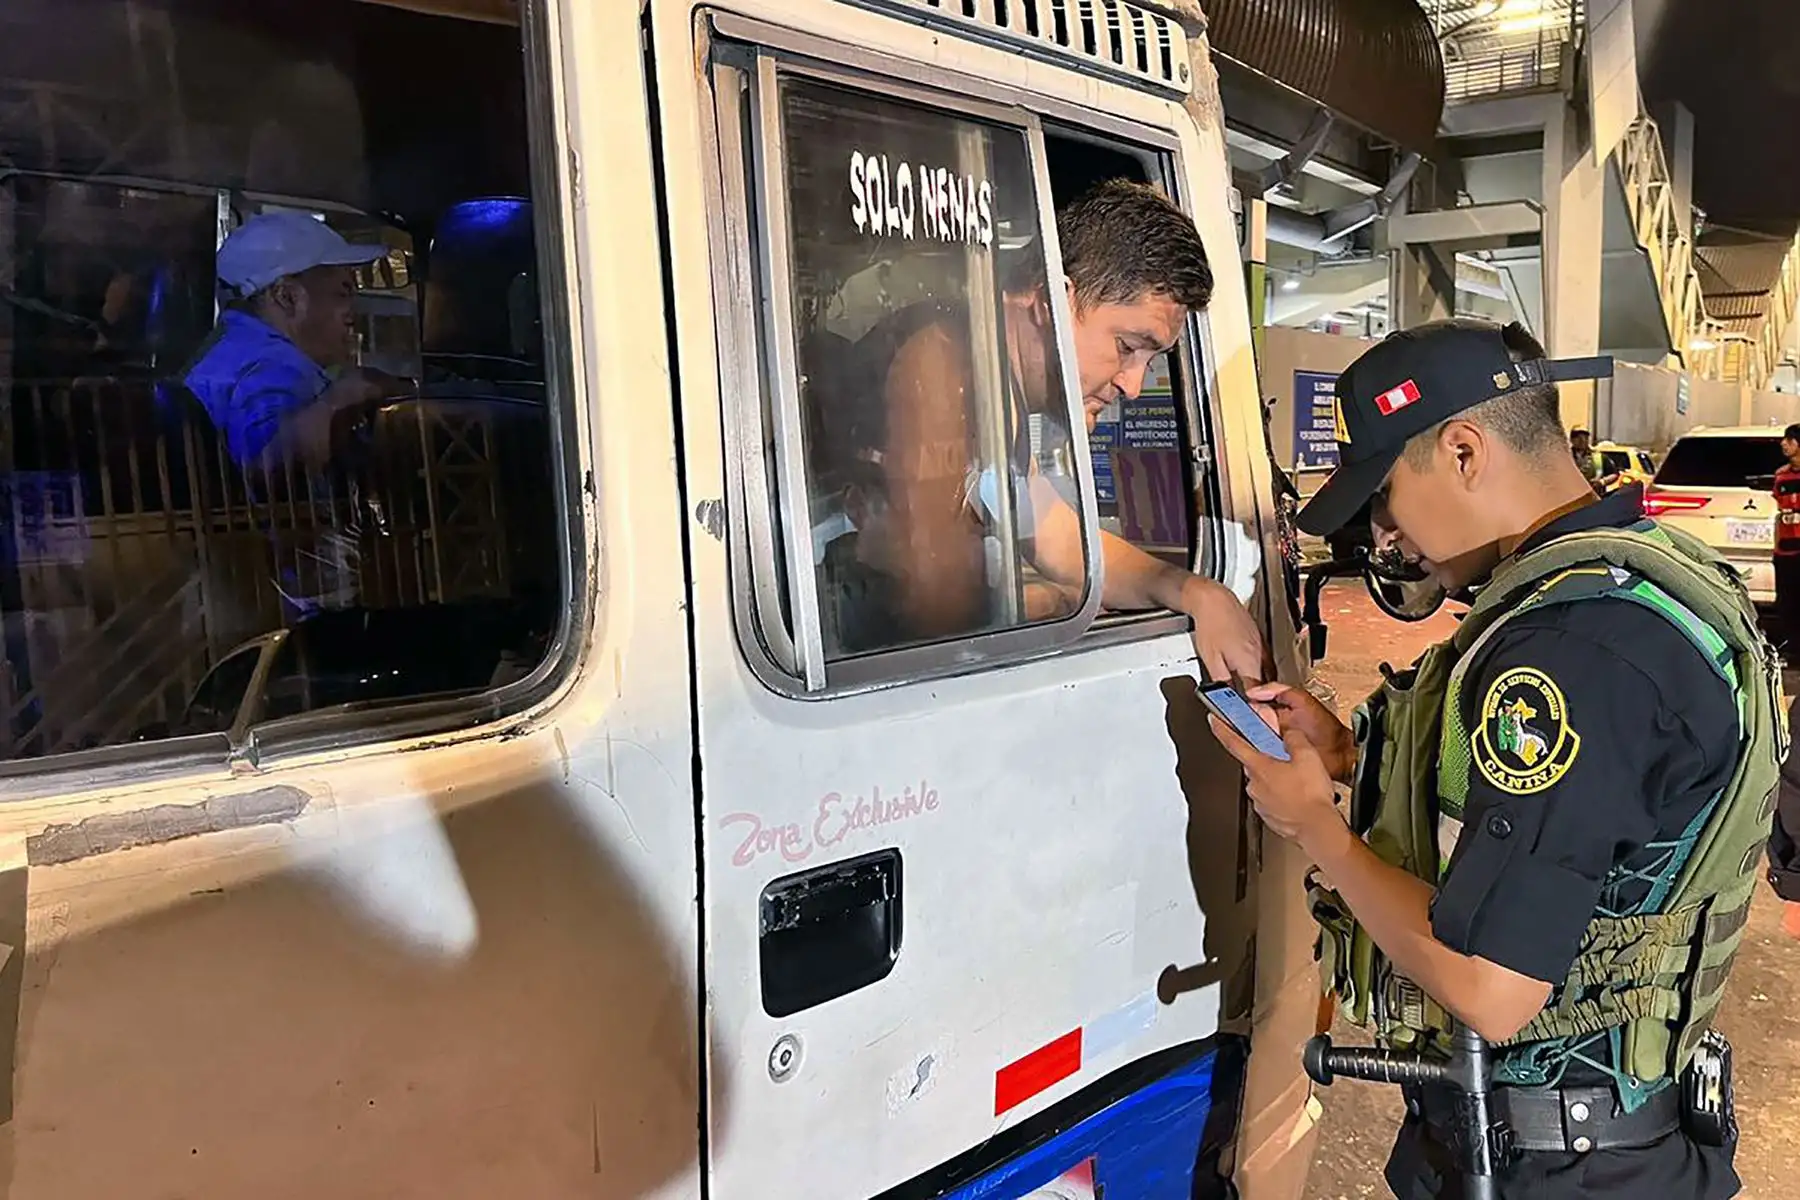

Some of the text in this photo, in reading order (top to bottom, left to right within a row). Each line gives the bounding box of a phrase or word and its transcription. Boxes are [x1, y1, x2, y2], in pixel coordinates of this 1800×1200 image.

[850, 149, 994, 253] SOLO NENAS
[1124, 406, 1136, 416] NO
[1124, 420, 1135, 429] EL
[1135, 420, 1168, 429] INGRESO
[1484, 759, 1565, 789] CANINA
[718, 812, 813, 867] Zona
